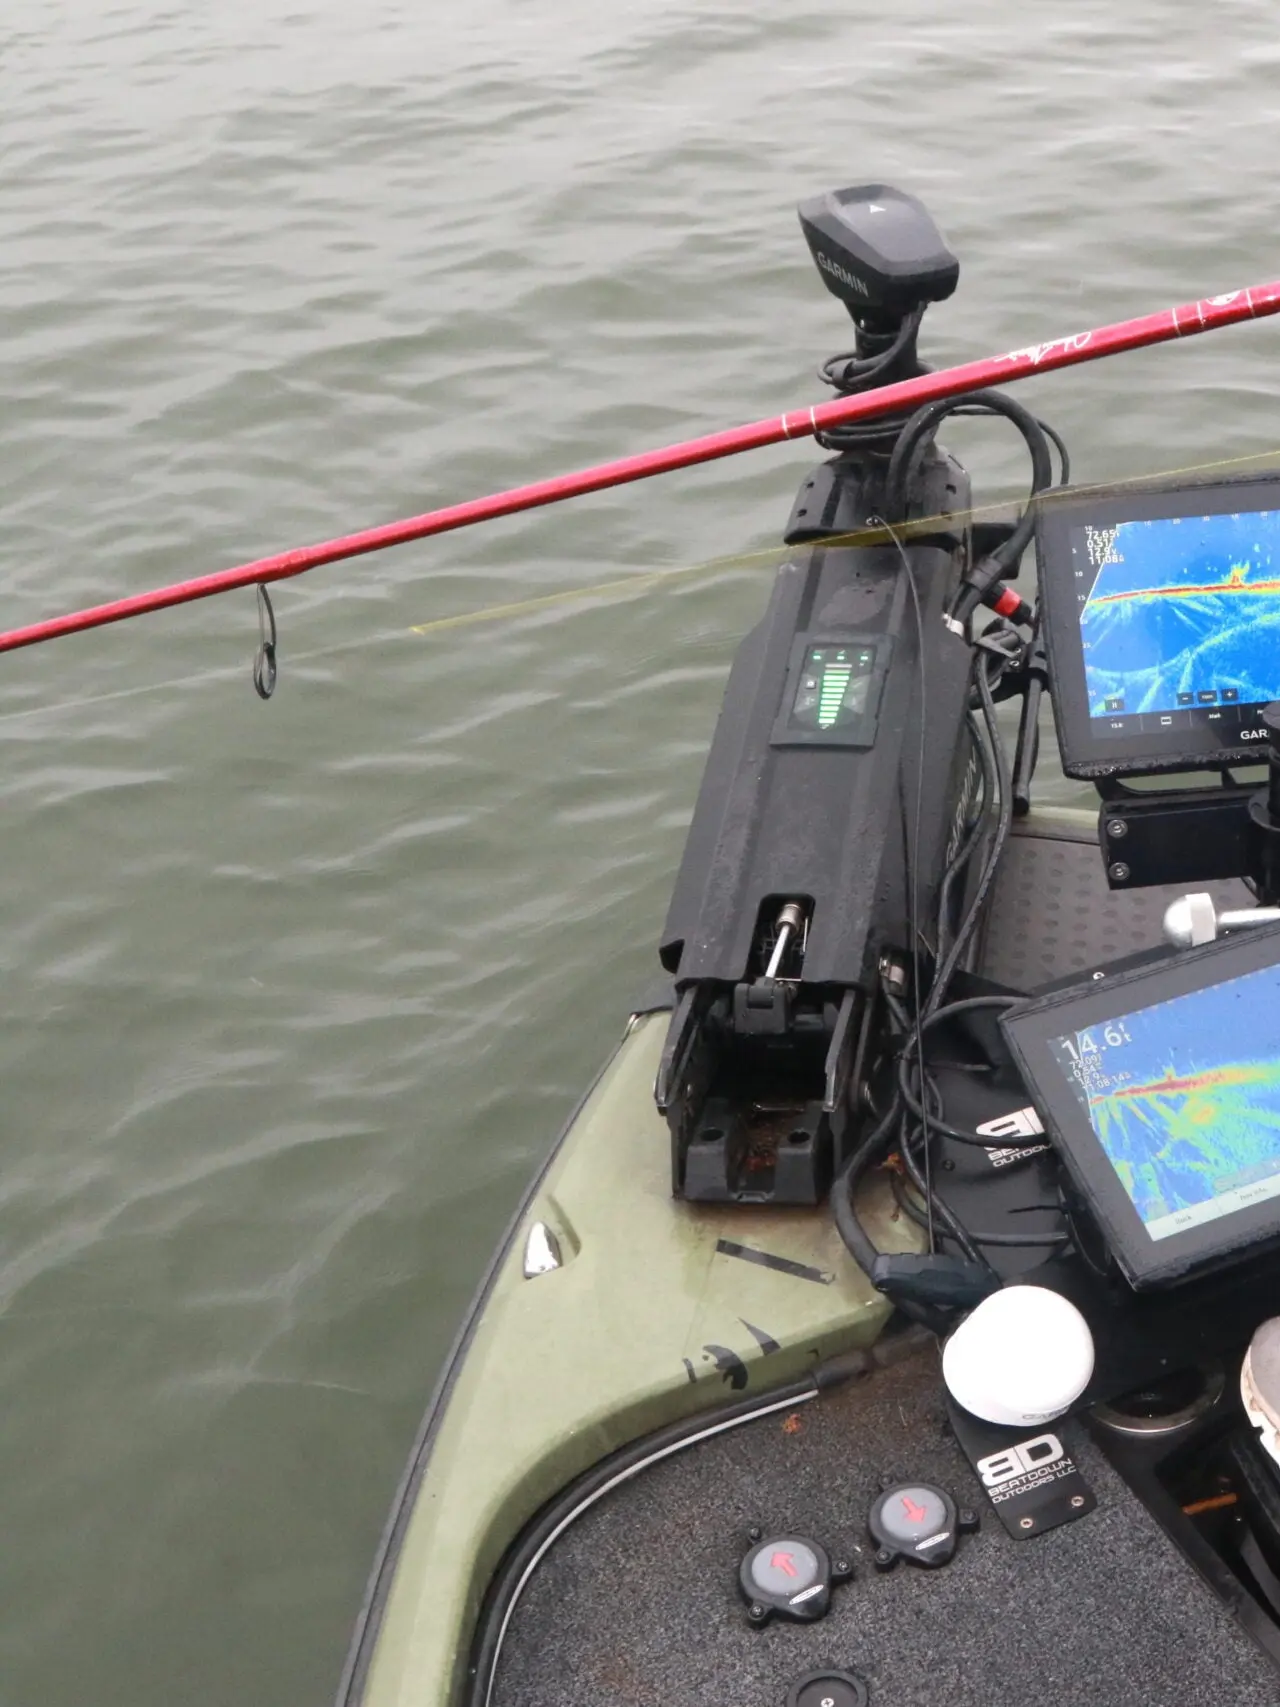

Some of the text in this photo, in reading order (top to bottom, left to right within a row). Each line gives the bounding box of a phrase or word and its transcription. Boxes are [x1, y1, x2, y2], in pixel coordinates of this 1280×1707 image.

[817, 250, 870, 299] GARMIN
[1240, 729, 1266, 741] GAR
[988, 1458, 1073, 1497] BEATDOWN
[992, 1465, 1077, 1504] OUTDOORS LLC
